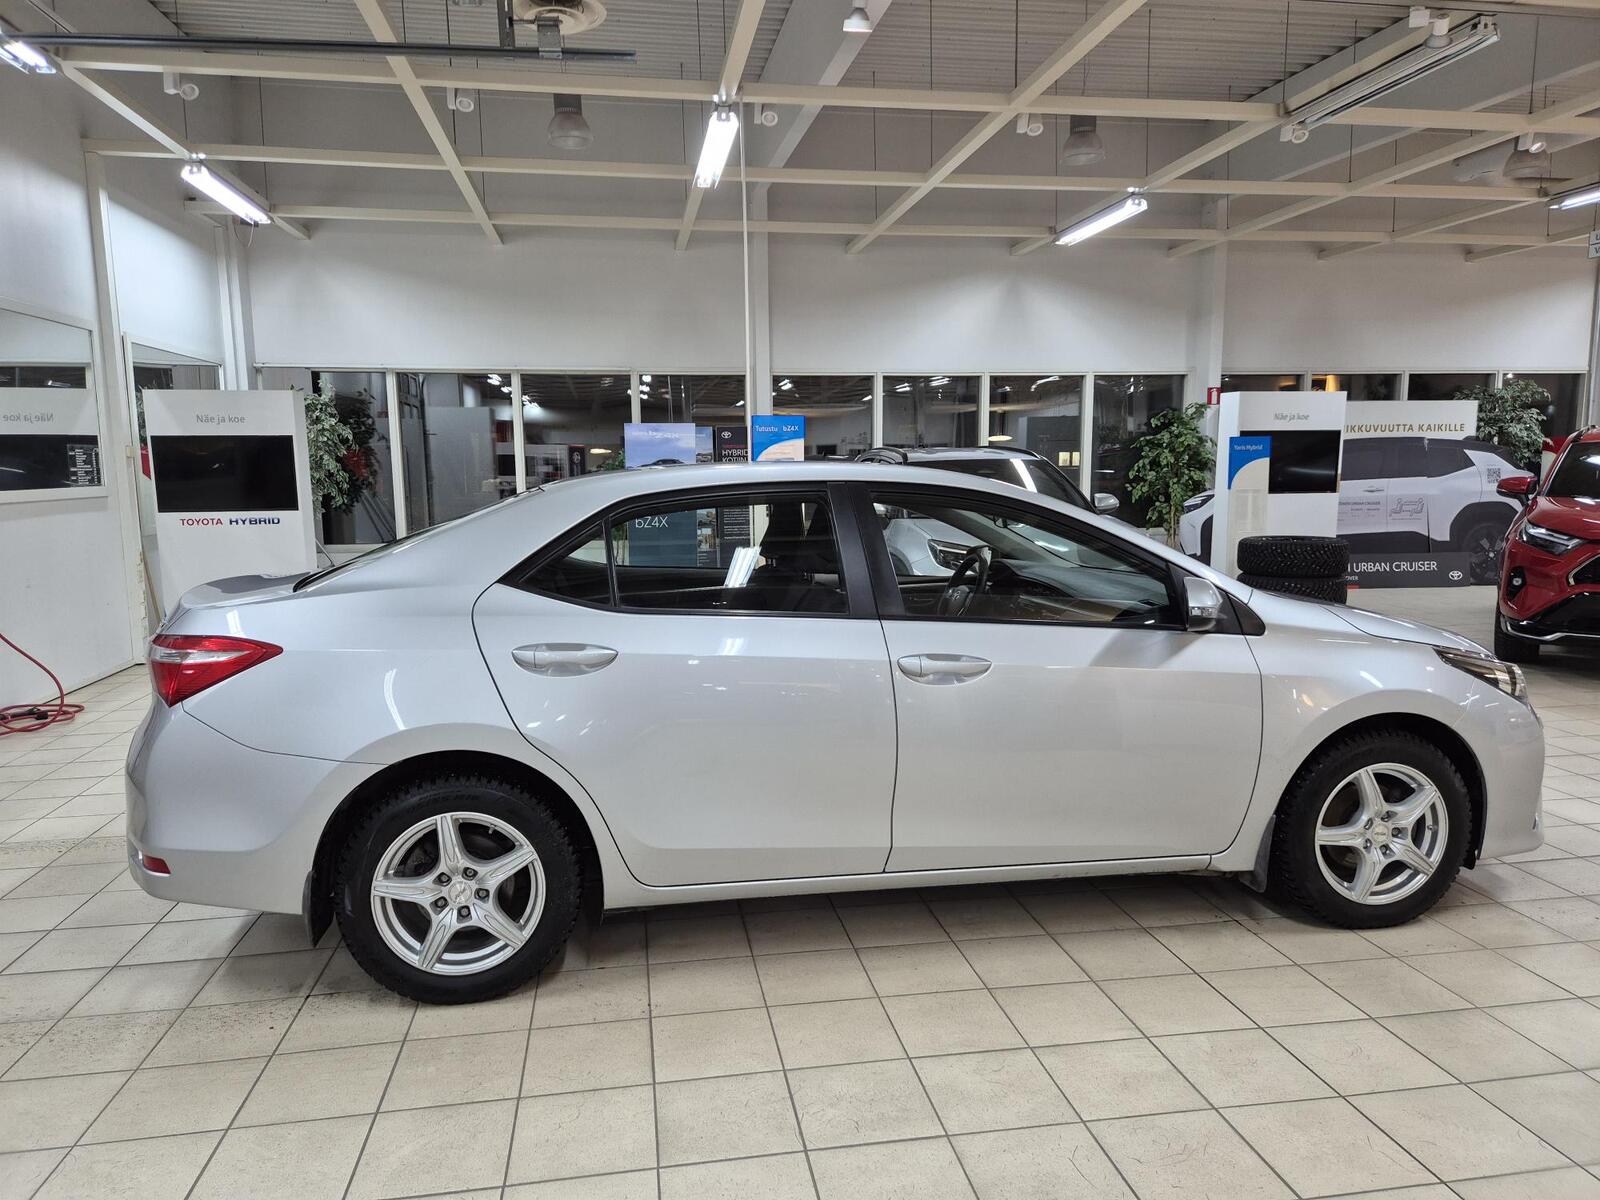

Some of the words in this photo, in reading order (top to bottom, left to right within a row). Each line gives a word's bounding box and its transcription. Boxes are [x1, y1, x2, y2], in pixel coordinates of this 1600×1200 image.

[196, 414, 215, 423] Näe
[216, 414, 226, 425] ja
[228, 414, 246, 423] koe
[1418, 423, 1465, 432] KAIKILLE
[722, 449, 748, 457] HYBRID
[180, 518, 224, 526] TOYOTA
[229, 517, 281, 525] HYBRID
[635, 516, 669, 528] bZ4X
[1353, 562, 1390, 573] URBAN
[1392, 561, 1438, 572] CRUISER
